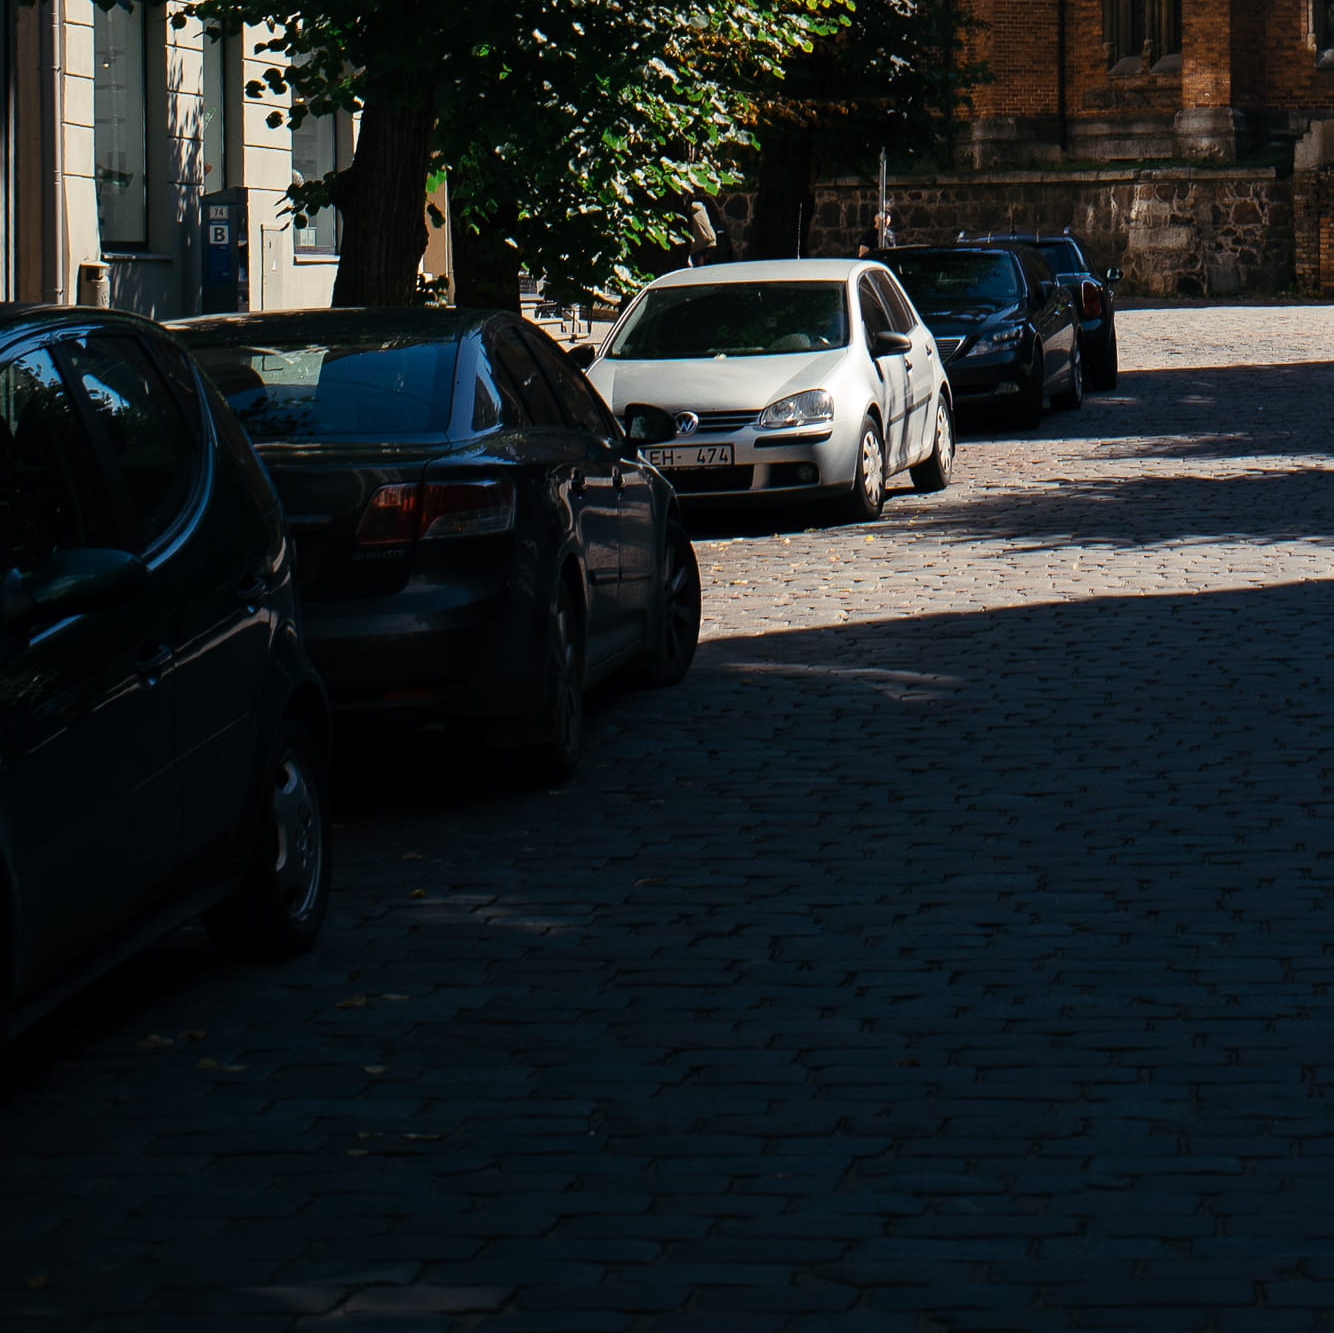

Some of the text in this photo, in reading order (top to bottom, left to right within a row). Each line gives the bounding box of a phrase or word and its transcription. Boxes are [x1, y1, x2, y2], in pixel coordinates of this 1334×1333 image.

[214, 208, 224, 217] 74
[214, 227, 225, 242] B
[697, 448, 728, 463] 474
